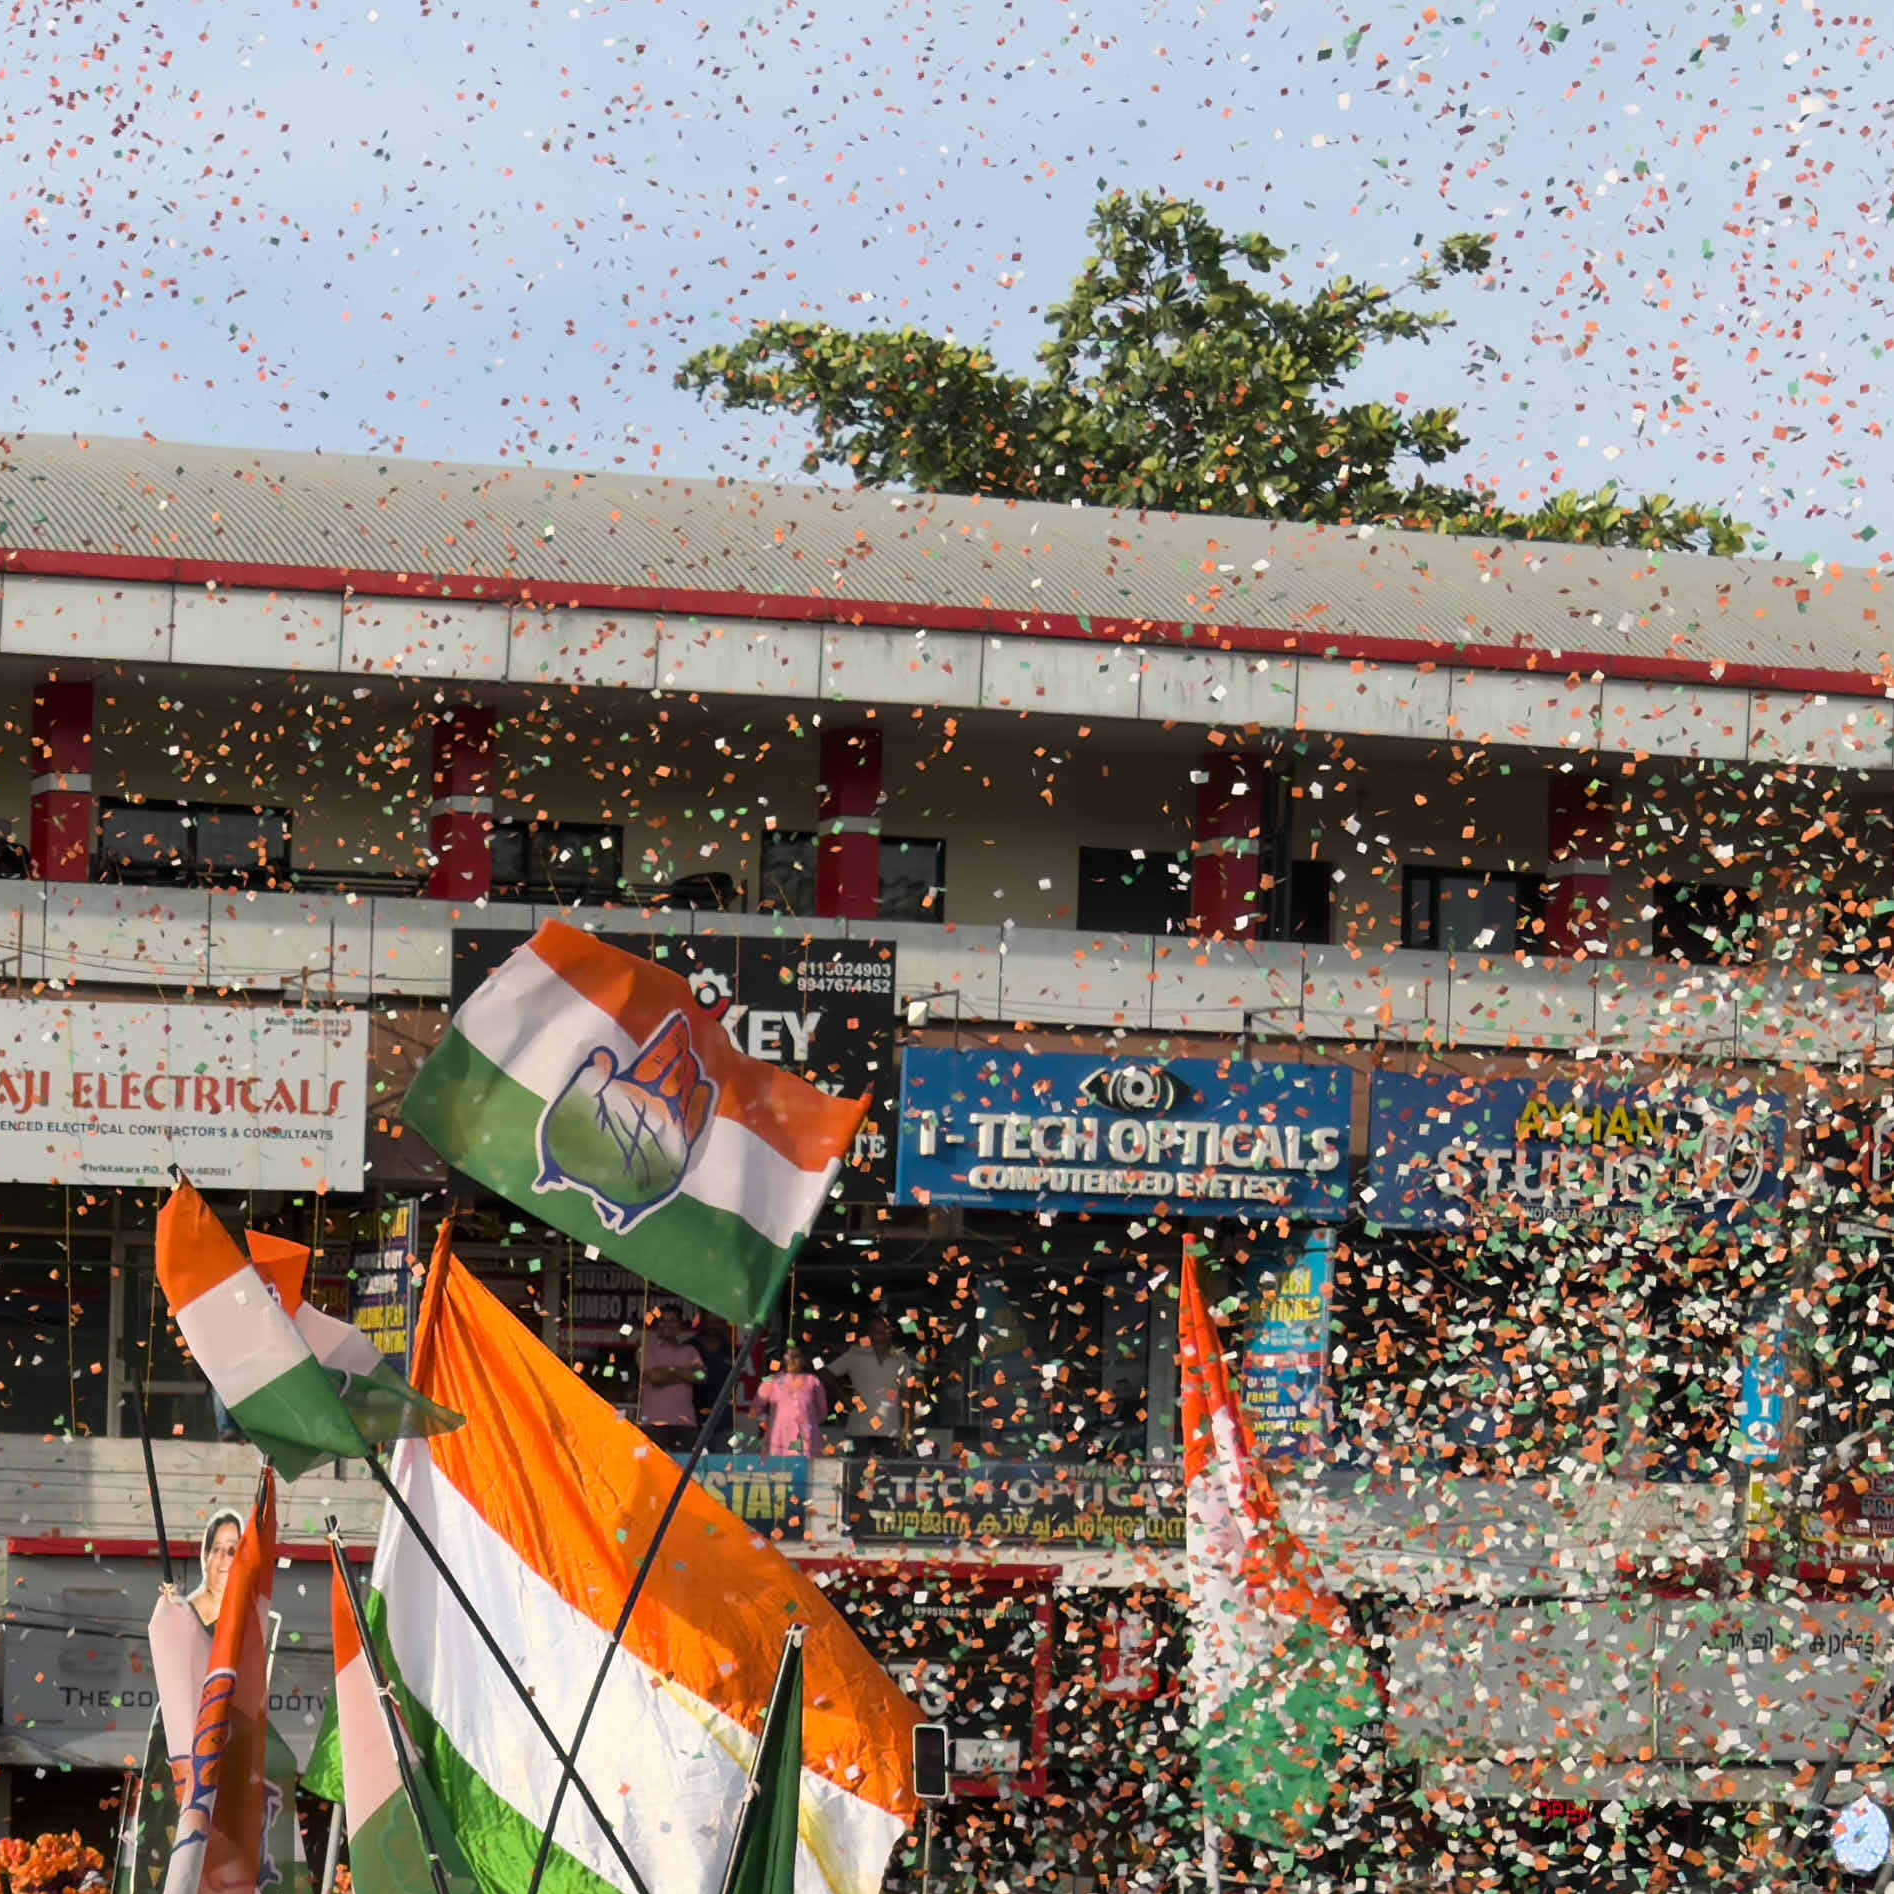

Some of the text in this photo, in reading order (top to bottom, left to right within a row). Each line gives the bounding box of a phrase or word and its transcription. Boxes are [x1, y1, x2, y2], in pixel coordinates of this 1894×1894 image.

[72, 1071, 348, 1118] ELECTRICALS
[242, 1126, 334, 1142] CONSULTANTS
[1108, 1117, 1340, 1172] OPTICALS
[968, 1165, 1174, 1197] COMPUTERIZED
